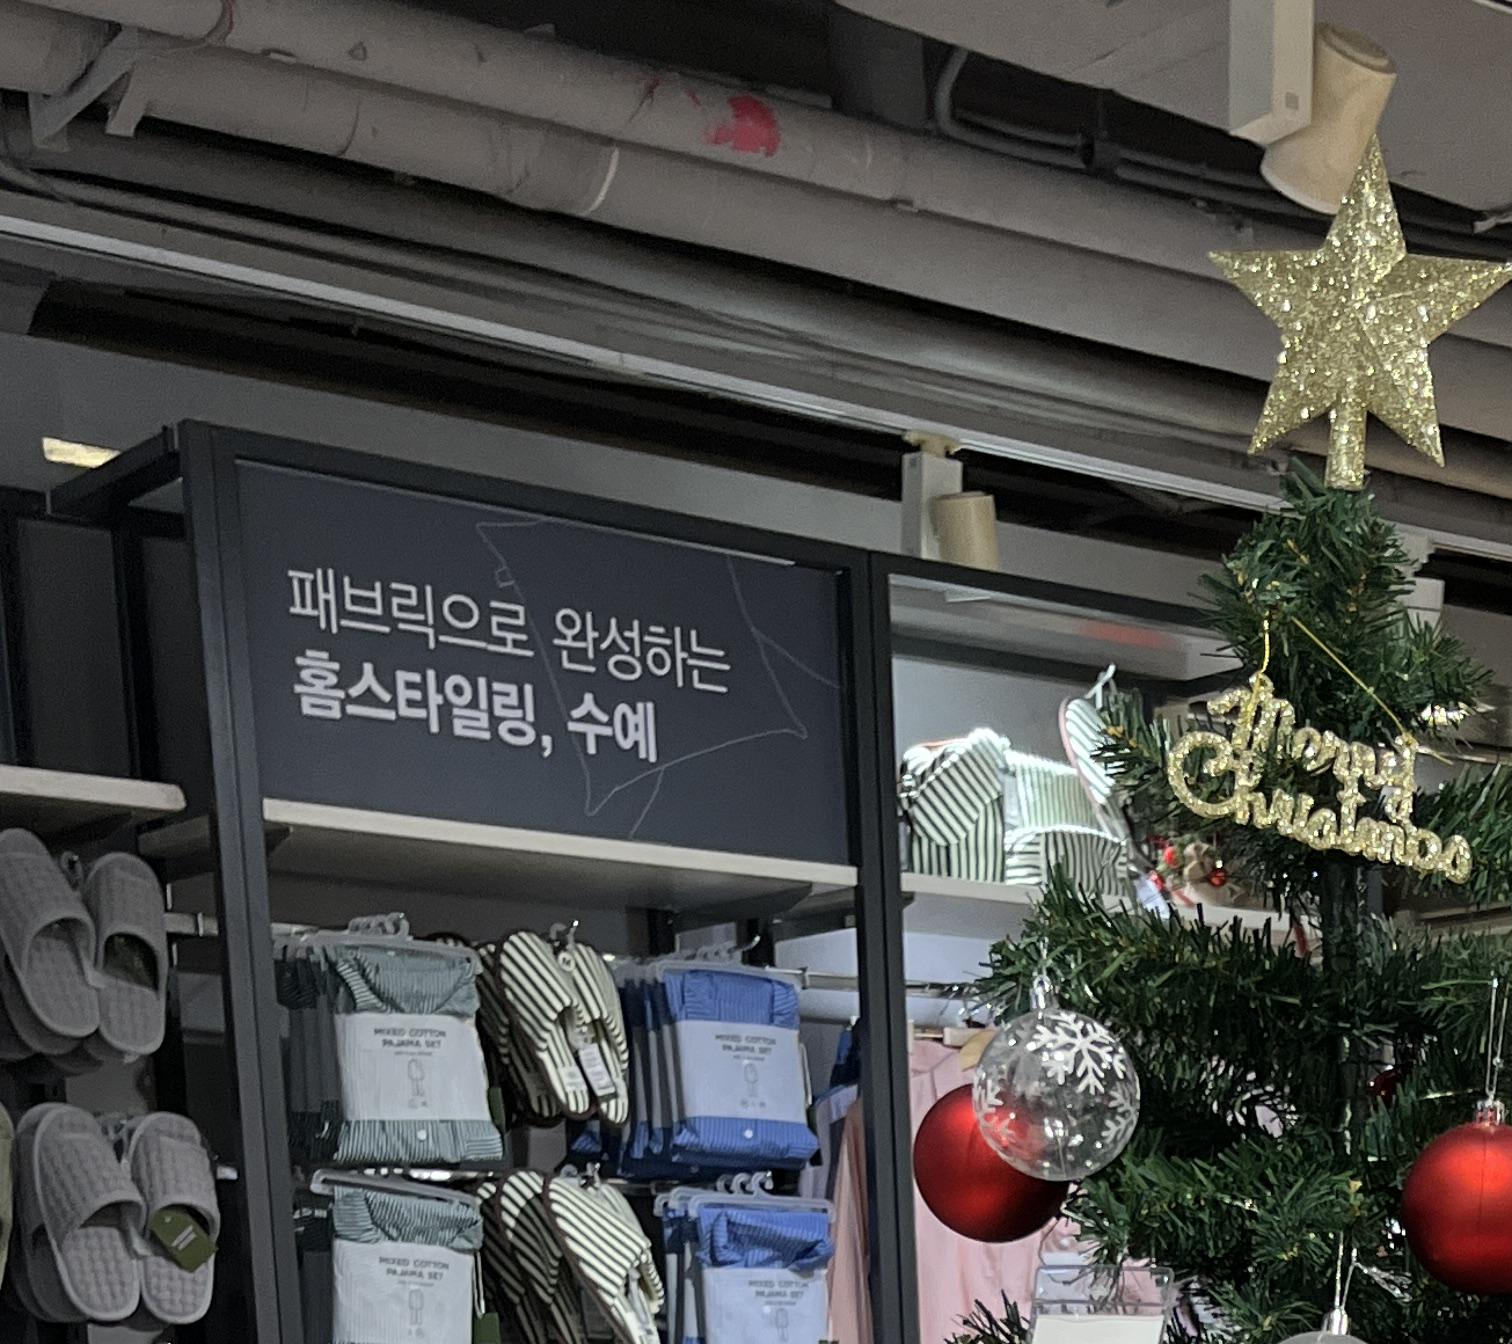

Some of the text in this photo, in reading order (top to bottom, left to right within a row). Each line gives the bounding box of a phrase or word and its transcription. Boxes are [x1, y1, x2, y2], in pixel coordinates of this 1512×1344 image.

[287, 568, 730, 694] 패브릭으로 완성하는
[294, 649, 657, 763] 홈스타일링, 수예
